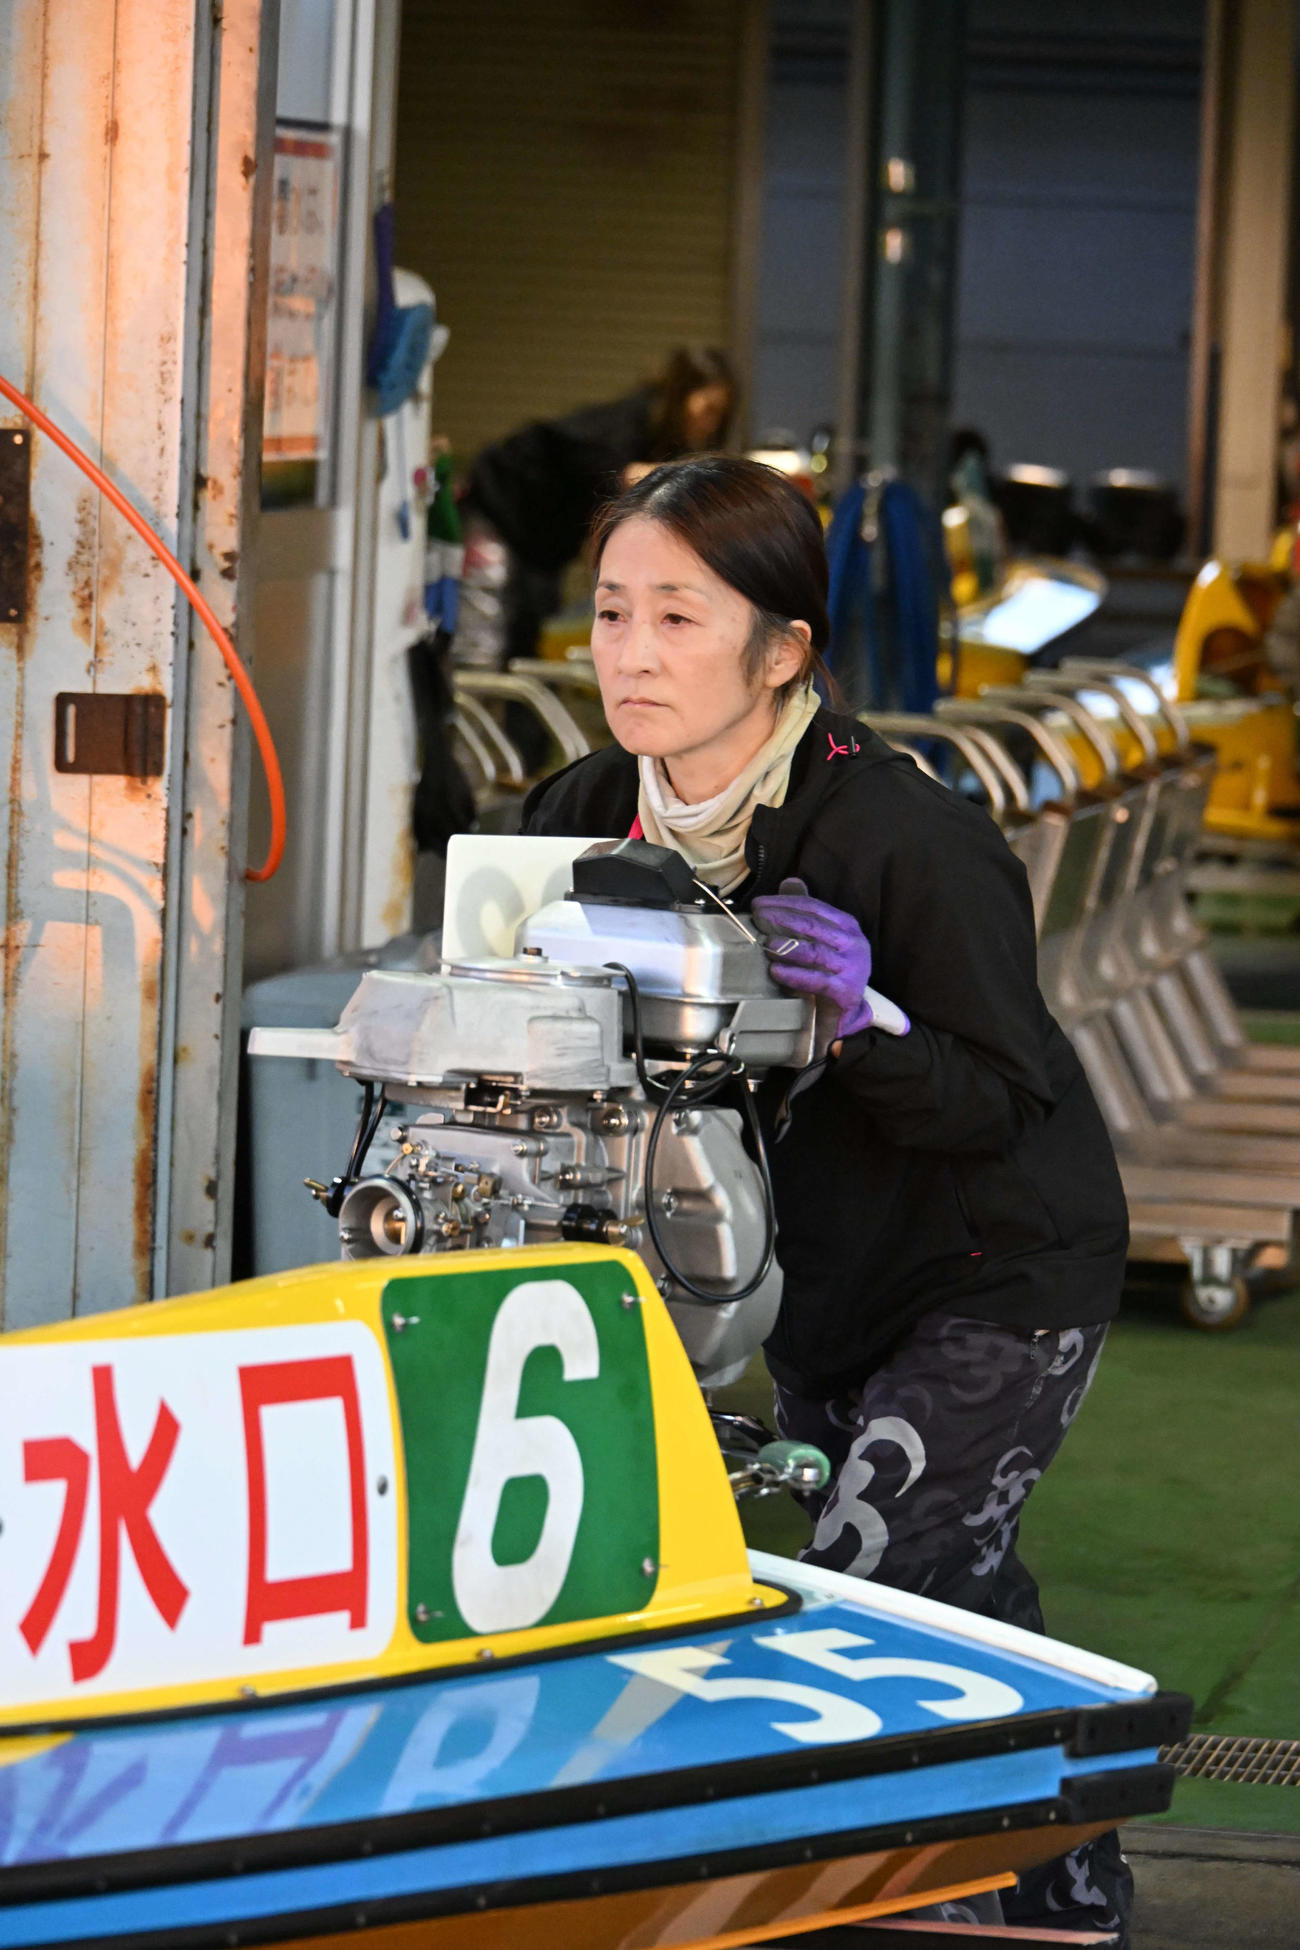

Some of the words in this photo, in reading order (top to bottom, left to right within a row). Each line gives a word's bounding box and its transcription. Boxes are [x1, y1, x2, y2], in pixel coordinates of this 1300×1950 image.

[18, 1353, 369, 1685] 水口
[452, 1279, 600, 1635] 6
[605, 1627, 1025, 1744] 55
